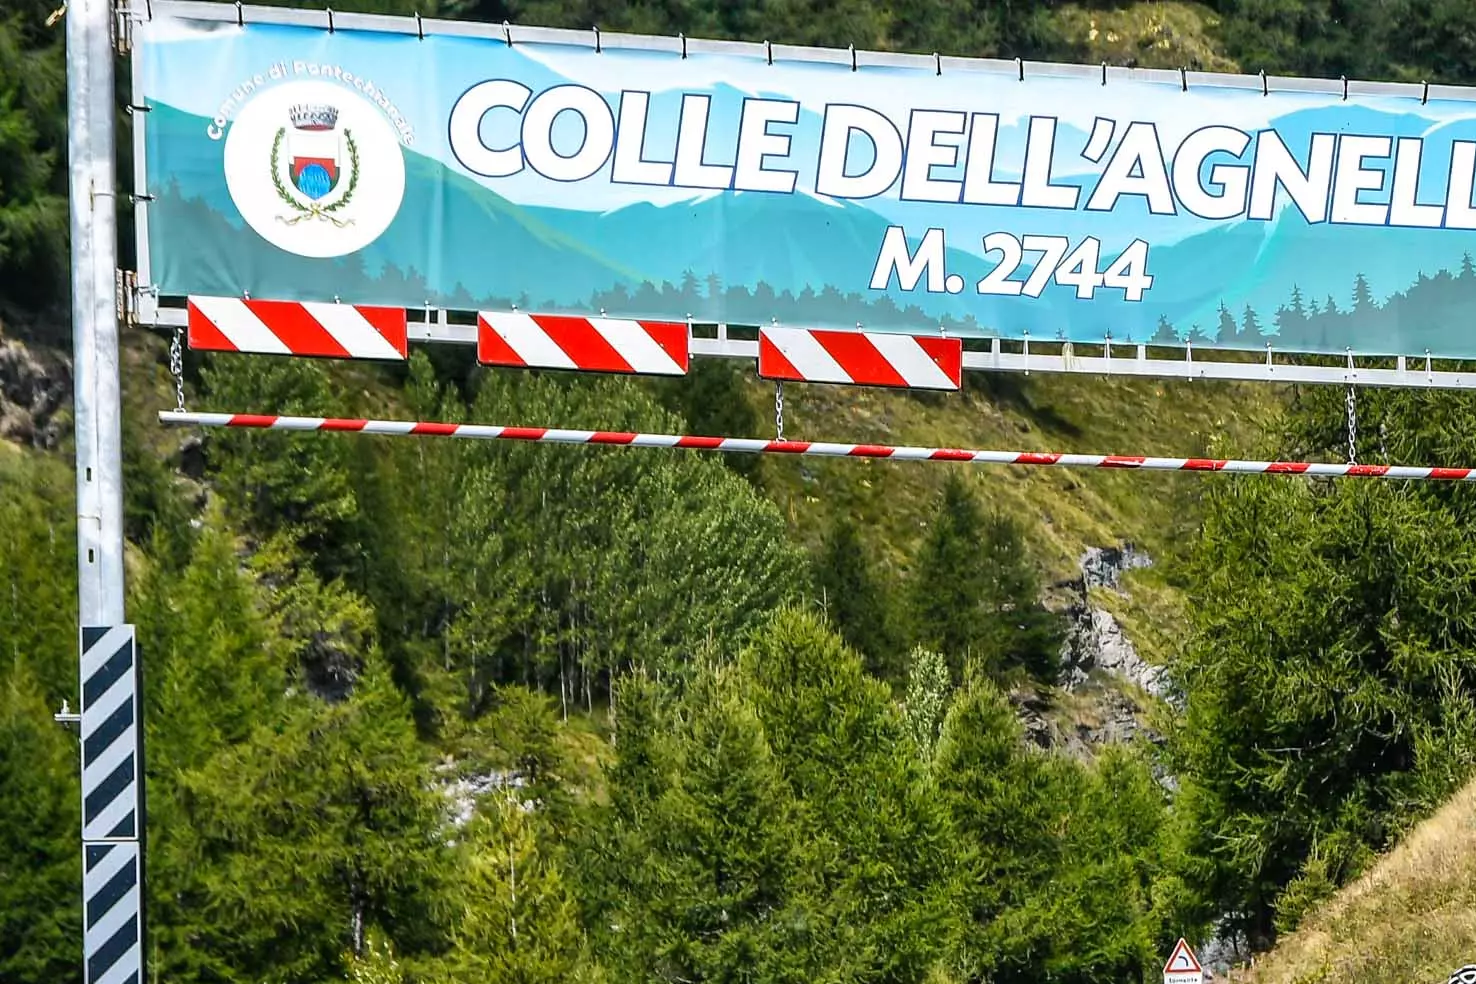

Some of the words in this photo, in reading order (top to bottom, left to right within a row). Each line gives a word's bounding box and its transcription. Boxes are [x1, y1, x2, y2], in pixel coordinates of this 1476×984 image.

[207, 74, 265, 140] Comune
[269, 60, 288, 80] di
[448, 78, 801, 194] COLLE
[869, 225, 965, 295] M.
[976, 230, 1154, 303] 2744
